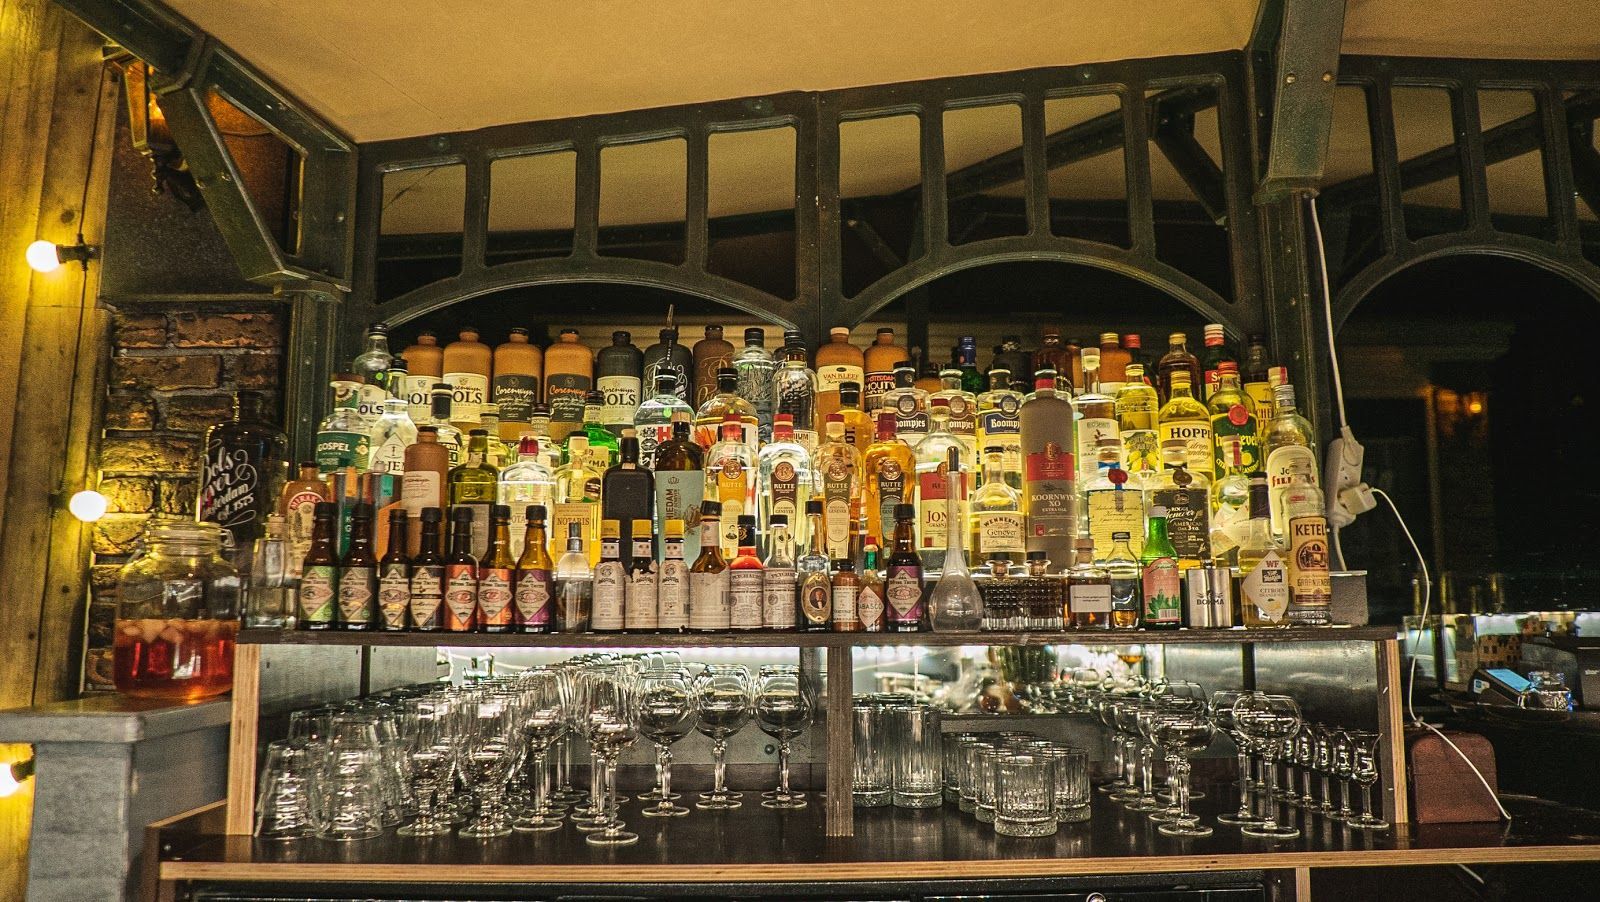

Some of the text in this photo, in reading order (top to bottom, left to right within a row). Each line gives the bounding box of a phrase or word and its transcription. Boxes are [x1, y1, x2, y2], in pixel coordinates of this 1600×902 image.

[406, 392, 433, 405] OL
[452, 391, 483, 404] OLS
[604, 393, 637, 406] OLS
[358, 405, 385, 415] OLS
[895, 418, 926, 430] oompjes
[949, 418, 975, 430] ompjes
[990, 418, 1021, 430] Boomp
[666, 488, 674, 521] HIEDAM
[556, 517, 589, 526] NOTARIS
